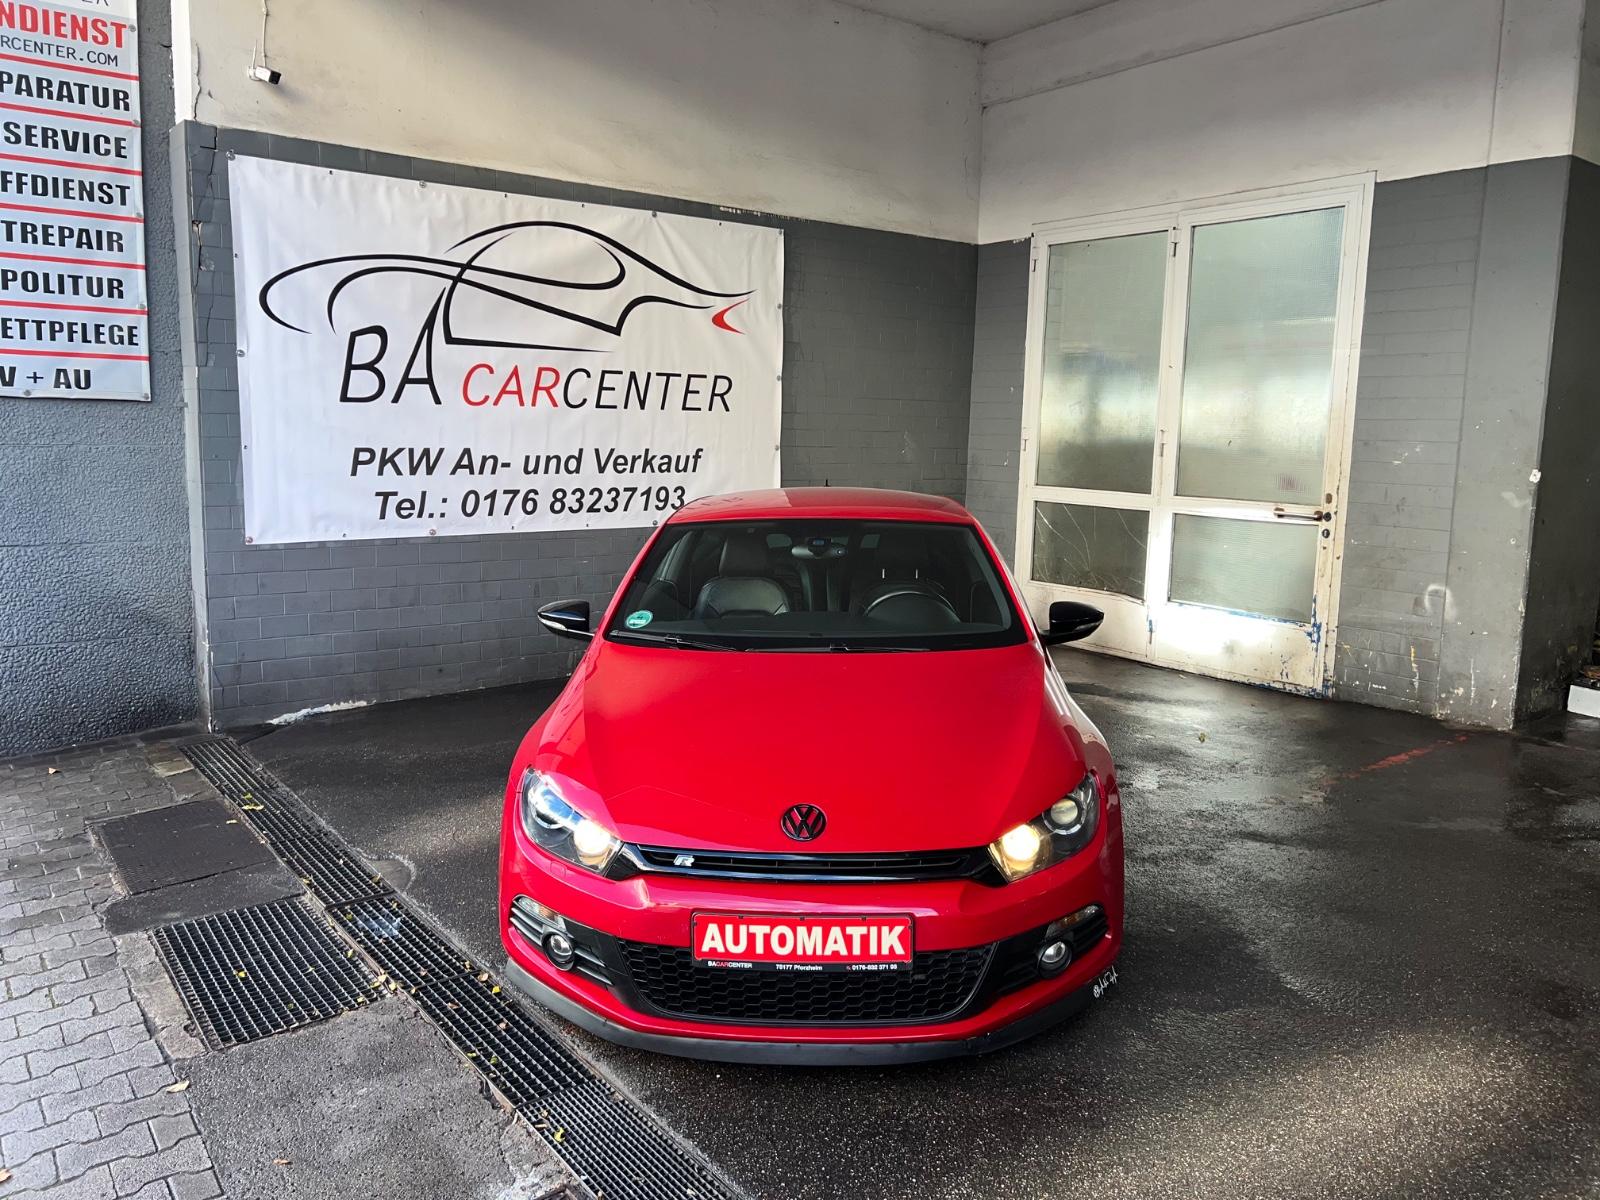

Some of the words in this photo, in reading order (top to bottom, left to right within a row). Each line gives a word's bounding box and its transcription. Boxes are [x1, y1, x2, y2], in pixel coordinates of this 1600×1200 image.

[0, 2, 127, 48] NDIENST
[1, 35, 118, 67] RCENTER.COM
[0, 71, 130, 112] PARATUR
[3, 121, 128, 159] SERVICE
[0, 170, 130, 206] FFDIENST
[1, 220, 124, 252] TREPAIR
[1, 268, 124, 299] POLITUR
[1, 317, 139, 346] ETTPFLEGE
[339, 286, 446, 405] BA
[462, 363, 733, 412] CARCENTER
[53, 368, 91, 390] AU
[350, 447, 444, 477] PKW
[450, 448, 511, 475] An-
[522, 448, 583, 475] und
[594, 448, 704, 475] Verkauf
[374, 490, 448, 520] Tel.:
[460, 488, 539, 517] 0176
[549, 485, 686, 514] 83237193
[701, 923, 905, 956] AUTOMATIK
